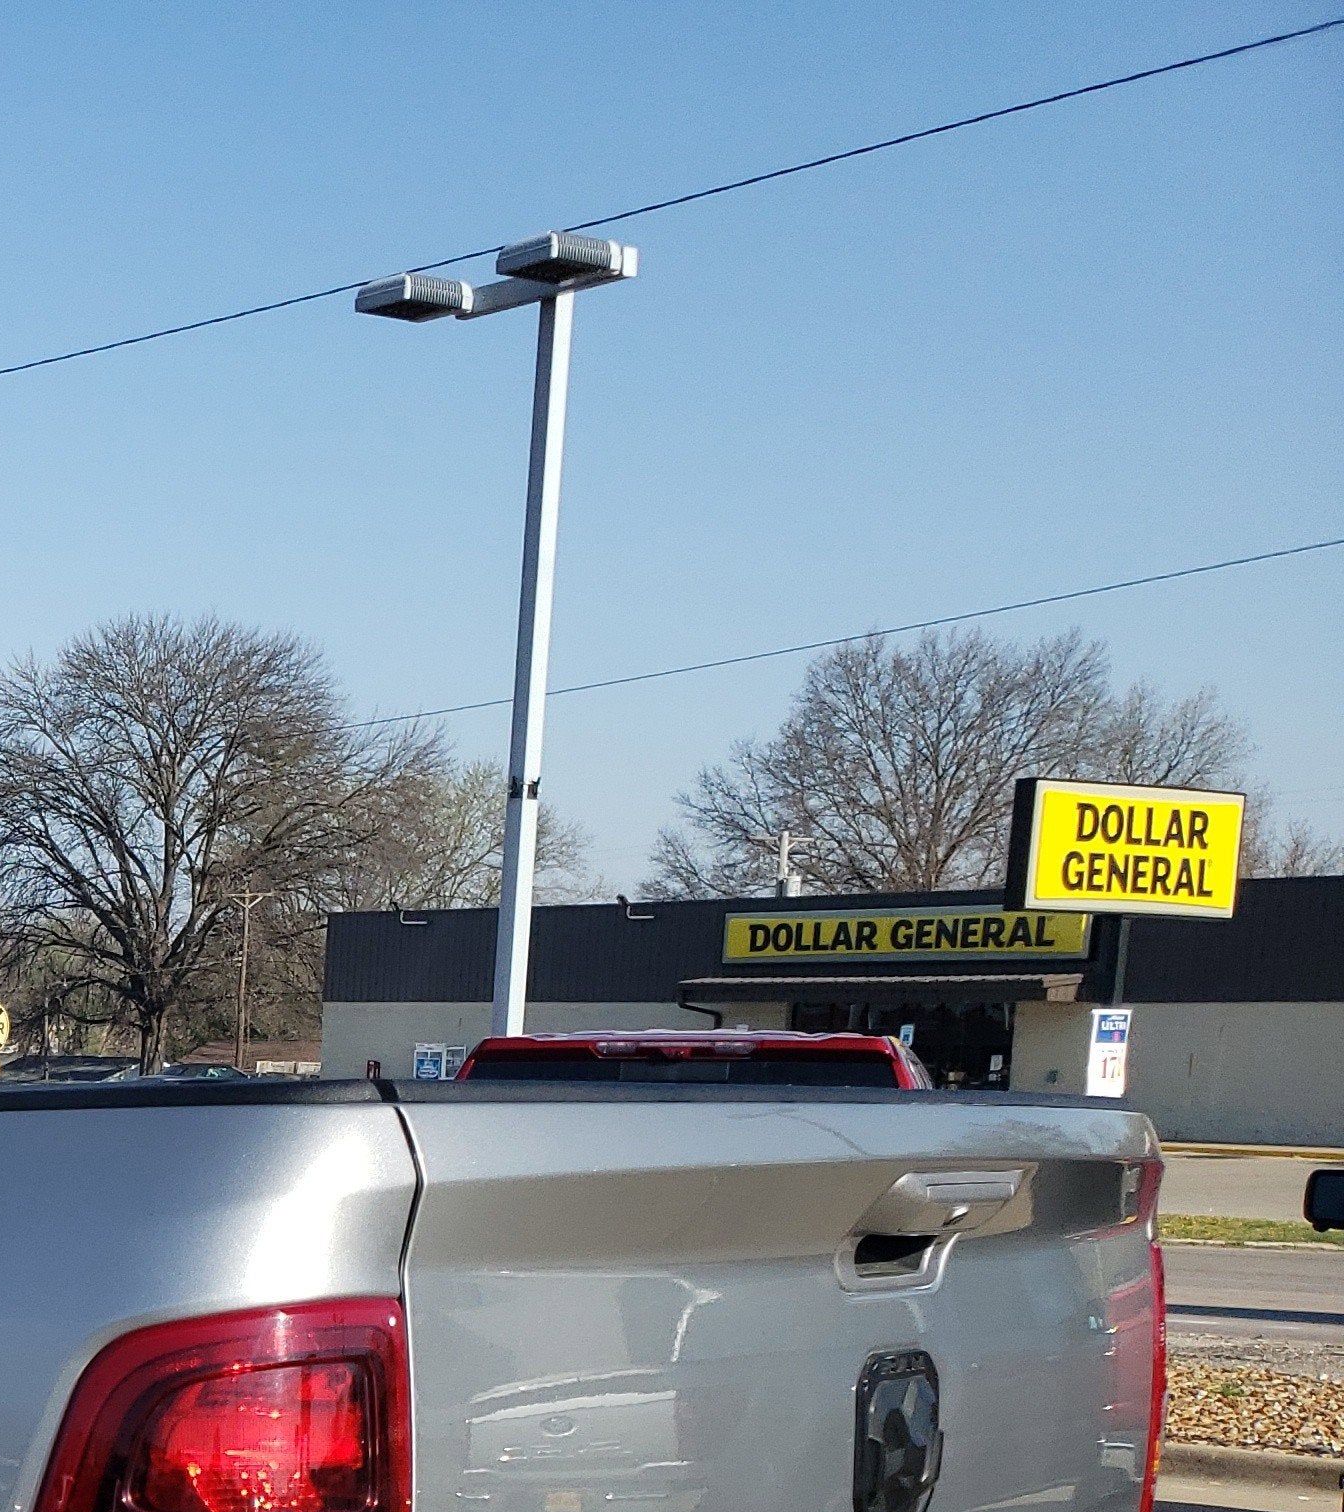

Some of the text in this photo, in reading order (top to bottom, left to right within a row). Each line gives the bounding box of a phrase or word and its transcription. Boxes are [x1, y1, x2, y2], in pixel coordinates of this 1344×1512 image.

[1075, 801, 1210, 850] DOLLAR
[1061, 850, 1213, 898] GENERAL
[748, 915, 1056, 953] DOLLAR GENERAL
